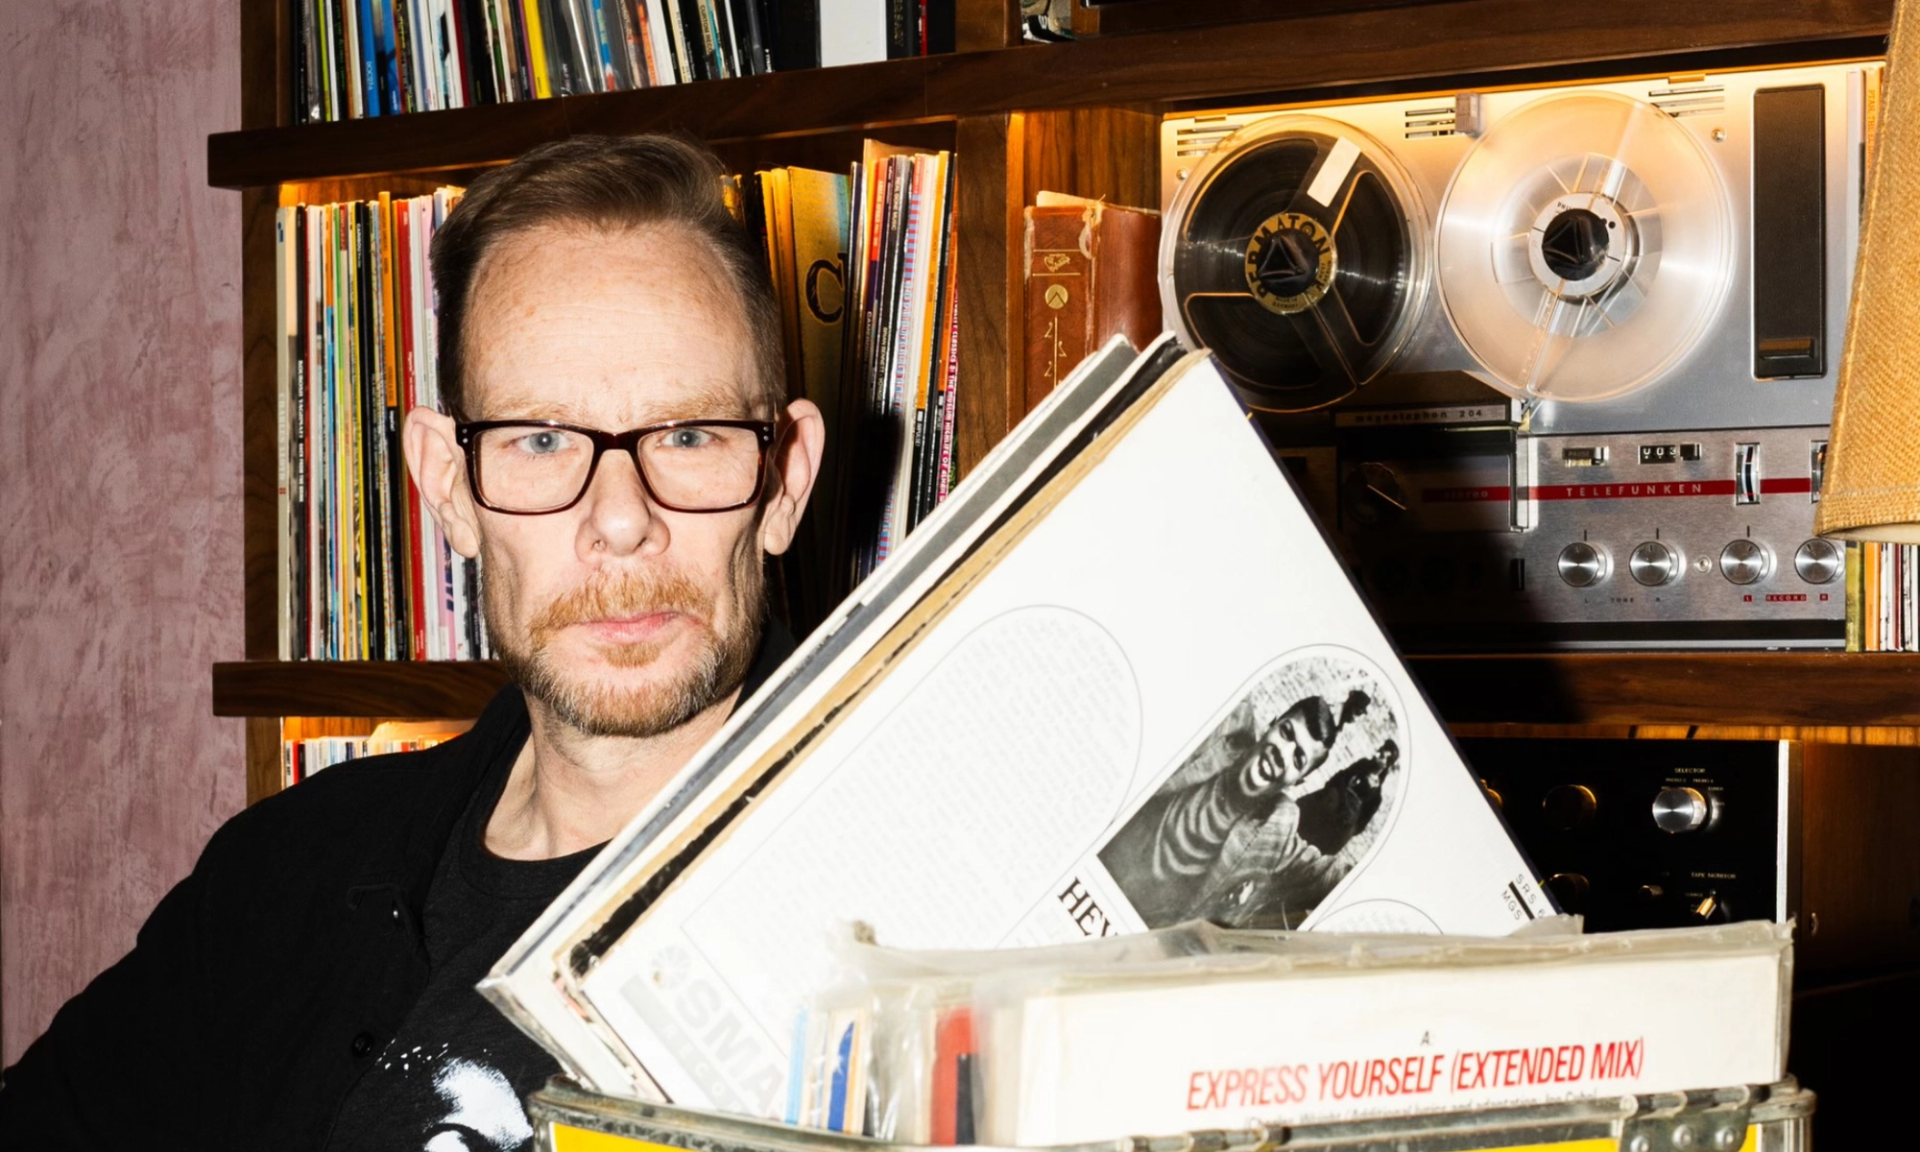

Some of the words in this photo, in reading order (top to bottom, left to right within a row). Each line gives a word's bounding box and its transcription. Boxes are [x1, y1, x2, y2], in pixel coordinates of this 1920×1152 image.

[879, 346, 887, 373] BENNETT
[948, 374, 956, 389] THE
[945, 391, 954, 421] MUSLIM
[1459, 409, 1482, 418] 204
[942, 422, 952, 455] HIGHLIFE
[278, 446, 286, 480] LLOYD
[941, 456, 949, 468] OF
[1566, 484, 1702, 497] TELEFUNKEN
[1516, 873, 1537, 905] SRS
[1501, 890, 1523, 920] MGS
[1186, 1064, 1307, 1110] EXPRESS
[1318, 1054, 1444, 1100] YOURSELF
[1450, 1044, 1585, 1094] (EXTENDED
[1591, 1036, 1645, 1082] MIX)
